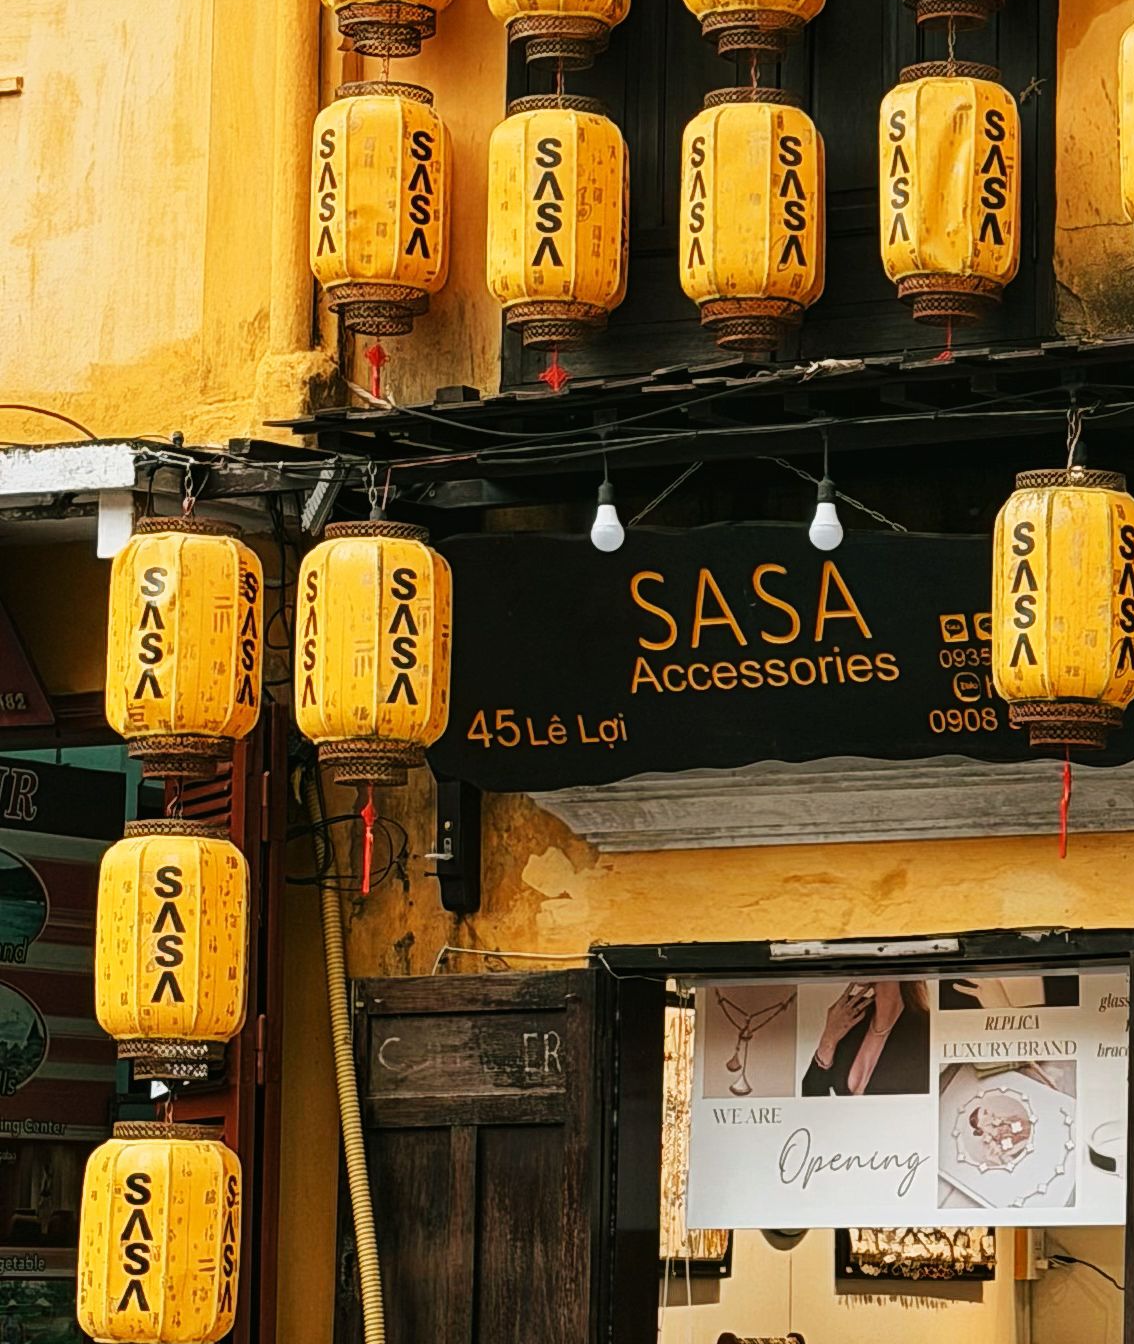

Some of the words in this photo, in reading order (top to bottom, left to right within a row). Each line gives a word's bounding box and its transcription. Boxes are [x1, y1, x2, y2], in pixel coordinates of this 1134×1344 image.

[318, 129, 336, 257] SASA
[405, 130, 434, 260] SASA
[532, 138, 564, 268] SASA
[689, 136, 705, 270] SASA
[779, 135, 807, 268] SASA
[889, 110, 910, 246] SASA
[979, 109, 1008, 246] SASA
[134, 567, 167, 700] SASA
[302, 570, 318, 708] SASA
[386, 567, 419, 706] SASA
[630, 560, 872, 650] SASA
[1009, 522, 1039, 668] SASA
[467, 709, 521, 748] 45
[526, 715, 568, 745] Lê
[630, 646, 900, 694] Accessories
[929, 708, 998, 733] 0908
[151, 865, 186, 1004] SASA
[943, 1041, 1014, 1058] LUXURY
[1017, 1040, 1077, 1056] BRAND
[985, 1015, 1040, 1031] REPLICA
[712, 1108, 743, 1125] WE
[745, 1108, 782, 1124] ARE
[779, 1127, 931, 1197] Opening
[117, 1172, 154, 1312] SASA
[219, 1174, 239, 1313] SASA
